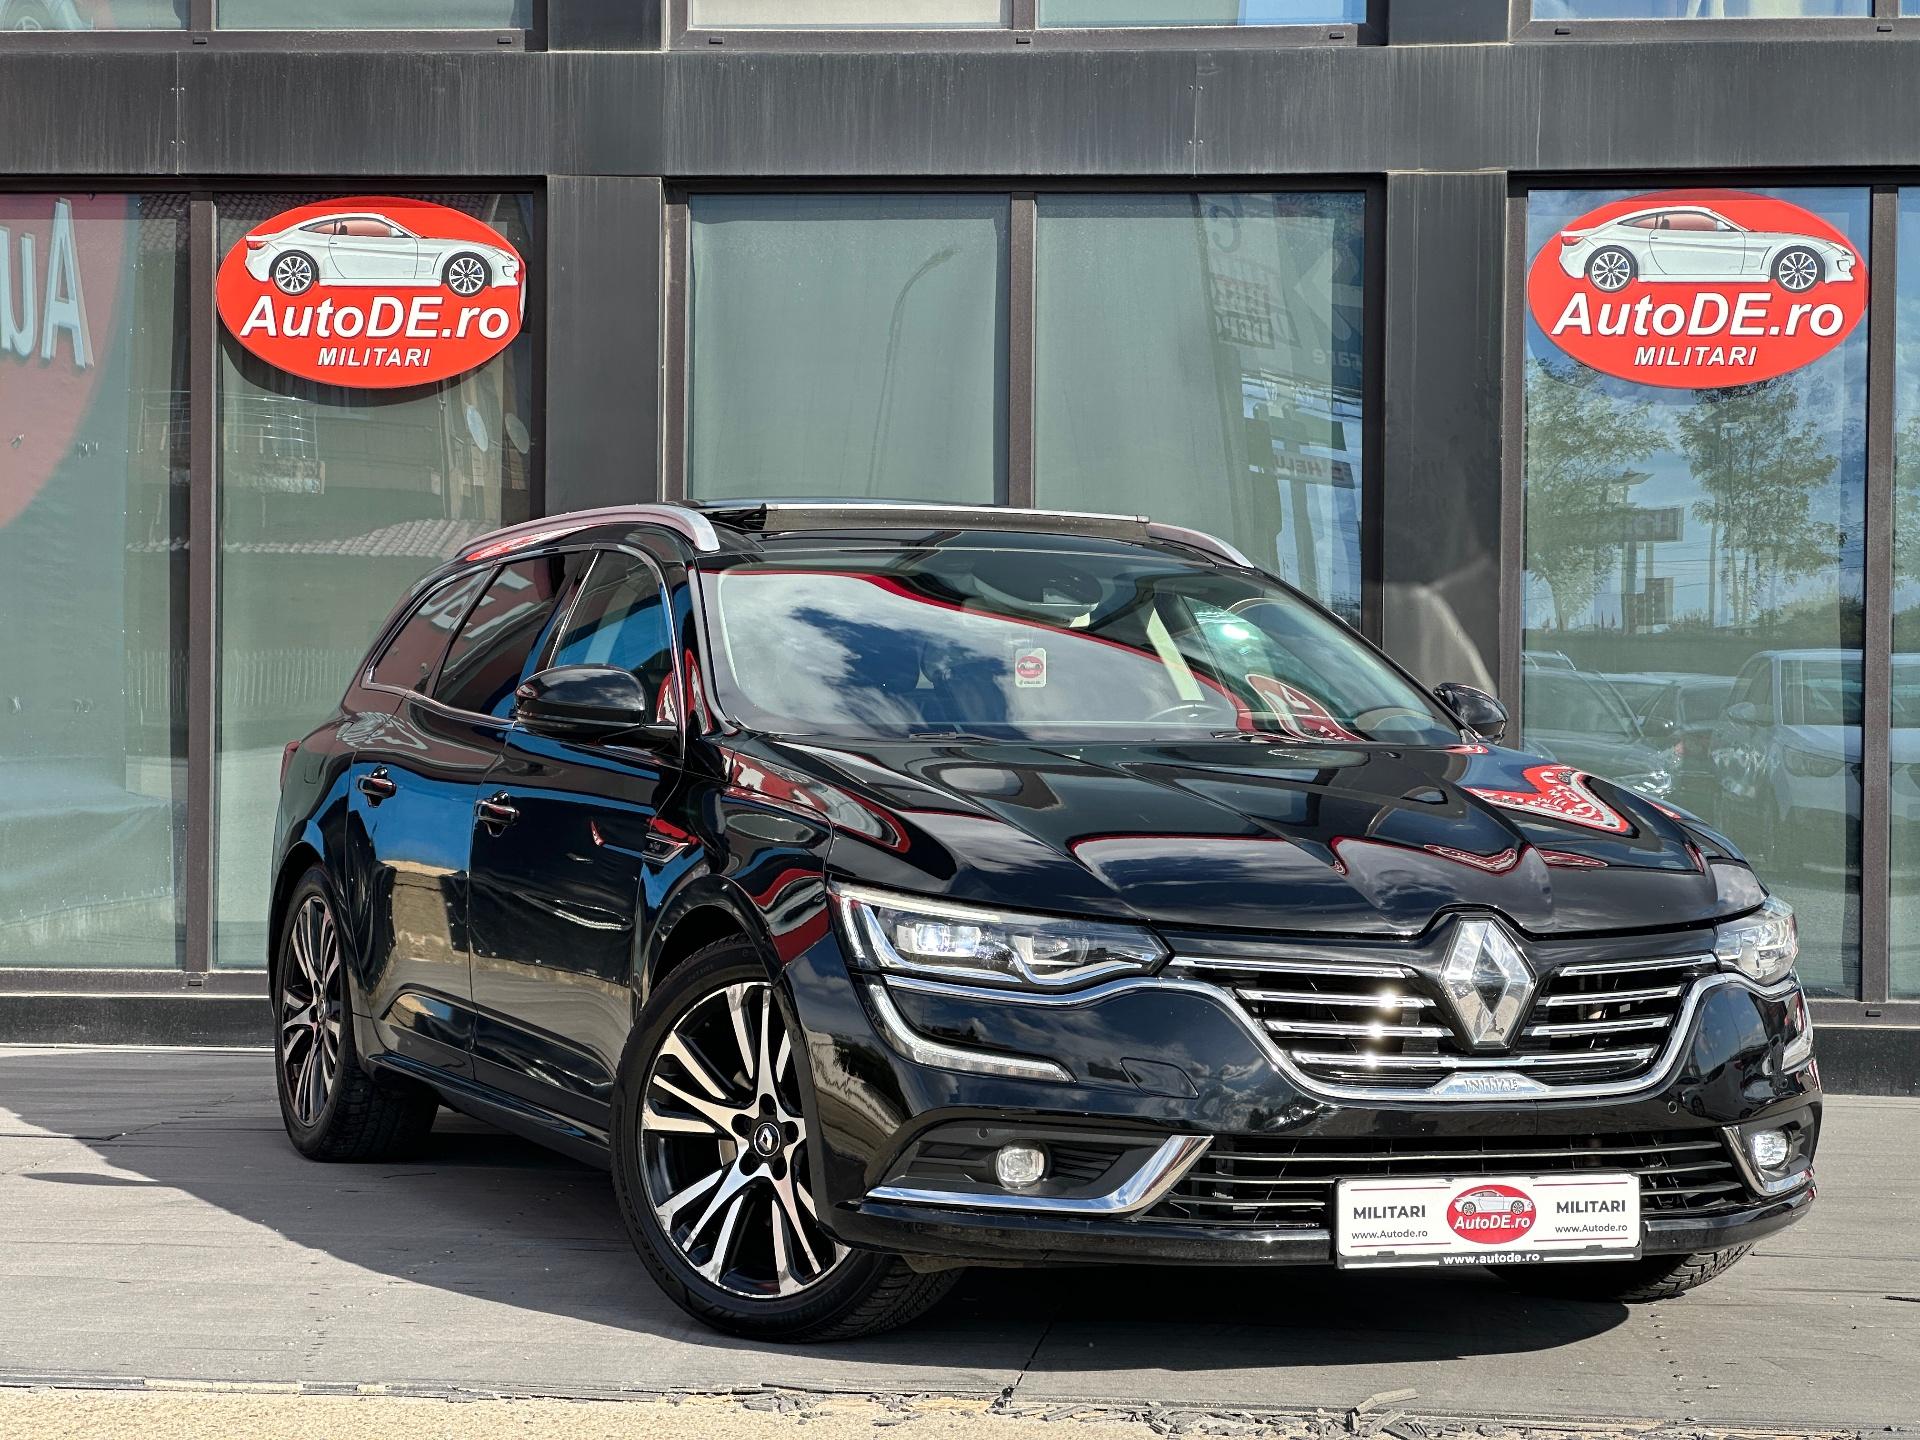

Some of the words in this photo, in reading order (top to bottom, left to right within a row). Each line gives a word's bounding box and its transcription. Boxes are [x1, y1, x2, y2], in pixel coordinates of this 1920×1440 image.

[240, 295, 510, 340] AutoDE.ro
[1551, 292, 1844, 338] AutoDE.ro
[317, 347, 431, 367] MILITARI
[1633, 346, 1757, 367] MILITARI
[1353, 1205, 1426, 1220] MILITARI
[1556, 1199, 1626, 1214] MILITARI
[1453, 1214, 1531, 1231] AutoDE.ro
[1555, 1222, 1628, 1234] www.Autode.ro
[1352, 1228, 1428, 1240] www.Autode.ro
[1443, 1251, 1540, 1265] www.autode.ro
